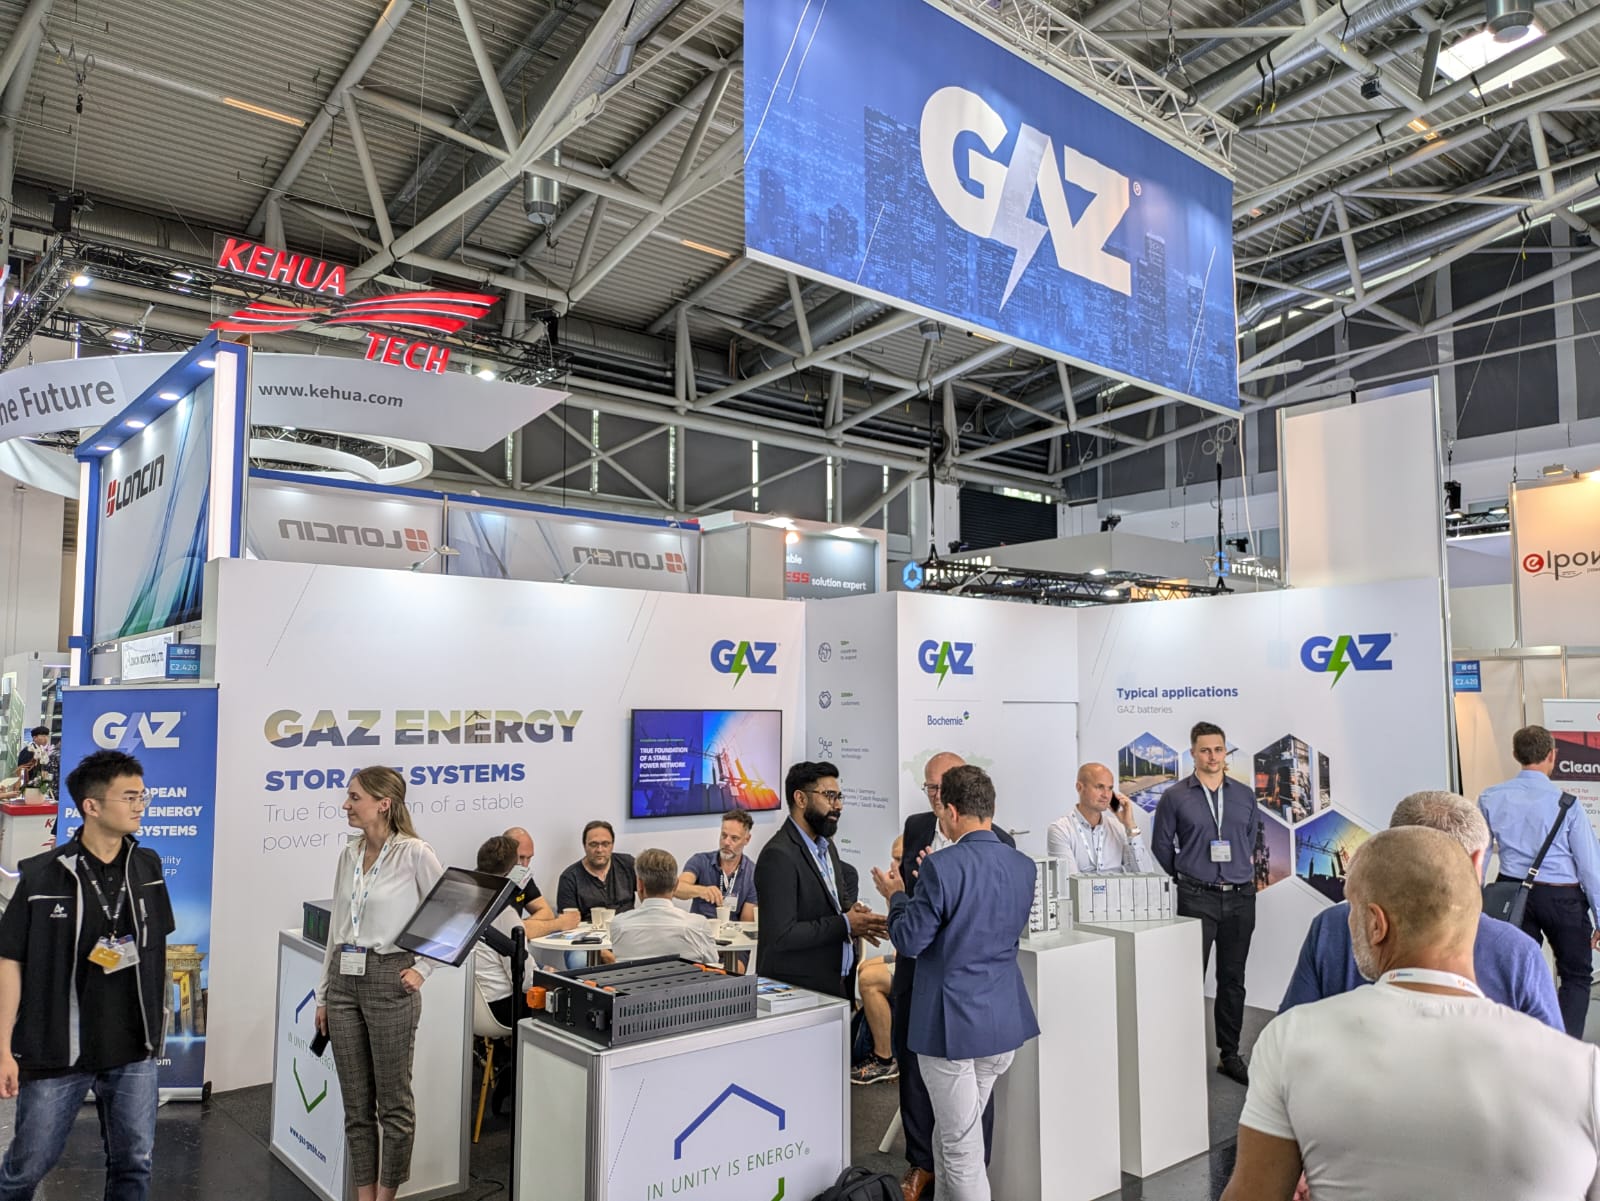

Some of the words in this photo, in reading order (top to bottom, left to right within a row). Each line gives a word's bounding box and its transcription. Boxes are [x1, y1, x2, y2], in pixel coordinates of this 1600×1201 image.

[920, 86, 1131, 313] GAZ
[217, 237, 346, 297] KEHUA
[364, 331, 450, 375] TECH
[19, 380, 116, 418] Future
[258, 383, 404, 408] www.kehua.com
[115, 453, 165, 510] LONCIN
[811, 577, 842, 588] solution
[842, 580, 867, 591] expert
[170, 663, 198, 671] C2.420
[711, 639, 777, 690] GAZ
[918, 639, 974, 690] GAZ
[1300, 633, 1393, 690] GAZ
[1117, 688, 1158, 701] Typical
[1161, 686, 1239, 700] applications
[1117, 705, 1135, 714] GAZ
[1137, 704, 1173, 714] batteries
[92, 711, 181, 754] GAZ
[264, 709, 381, 748] GAZ
[394, 709, 584, 745] ENERGY
[927, 714, 964, 726] Bochemie
[410, 763, 526, 785] SYSTEMS
[148, 806, 203, 817] ENERGY
[264, 803, 309, 825] True
[431, 795, 451, 813] of
[455, 799, 466, 812] a
[472, 793, 524, 811] stable
[135, 825, 198, 837] SYSTEMS
[263, 832, 333, 855] power
[647, 1181, 664, 1201] IN
[672, 1165, 721, 1193] UNITY
[728, 1159, 740, 1176] IS
[747, 1140, 804, 1171] ENERGY
